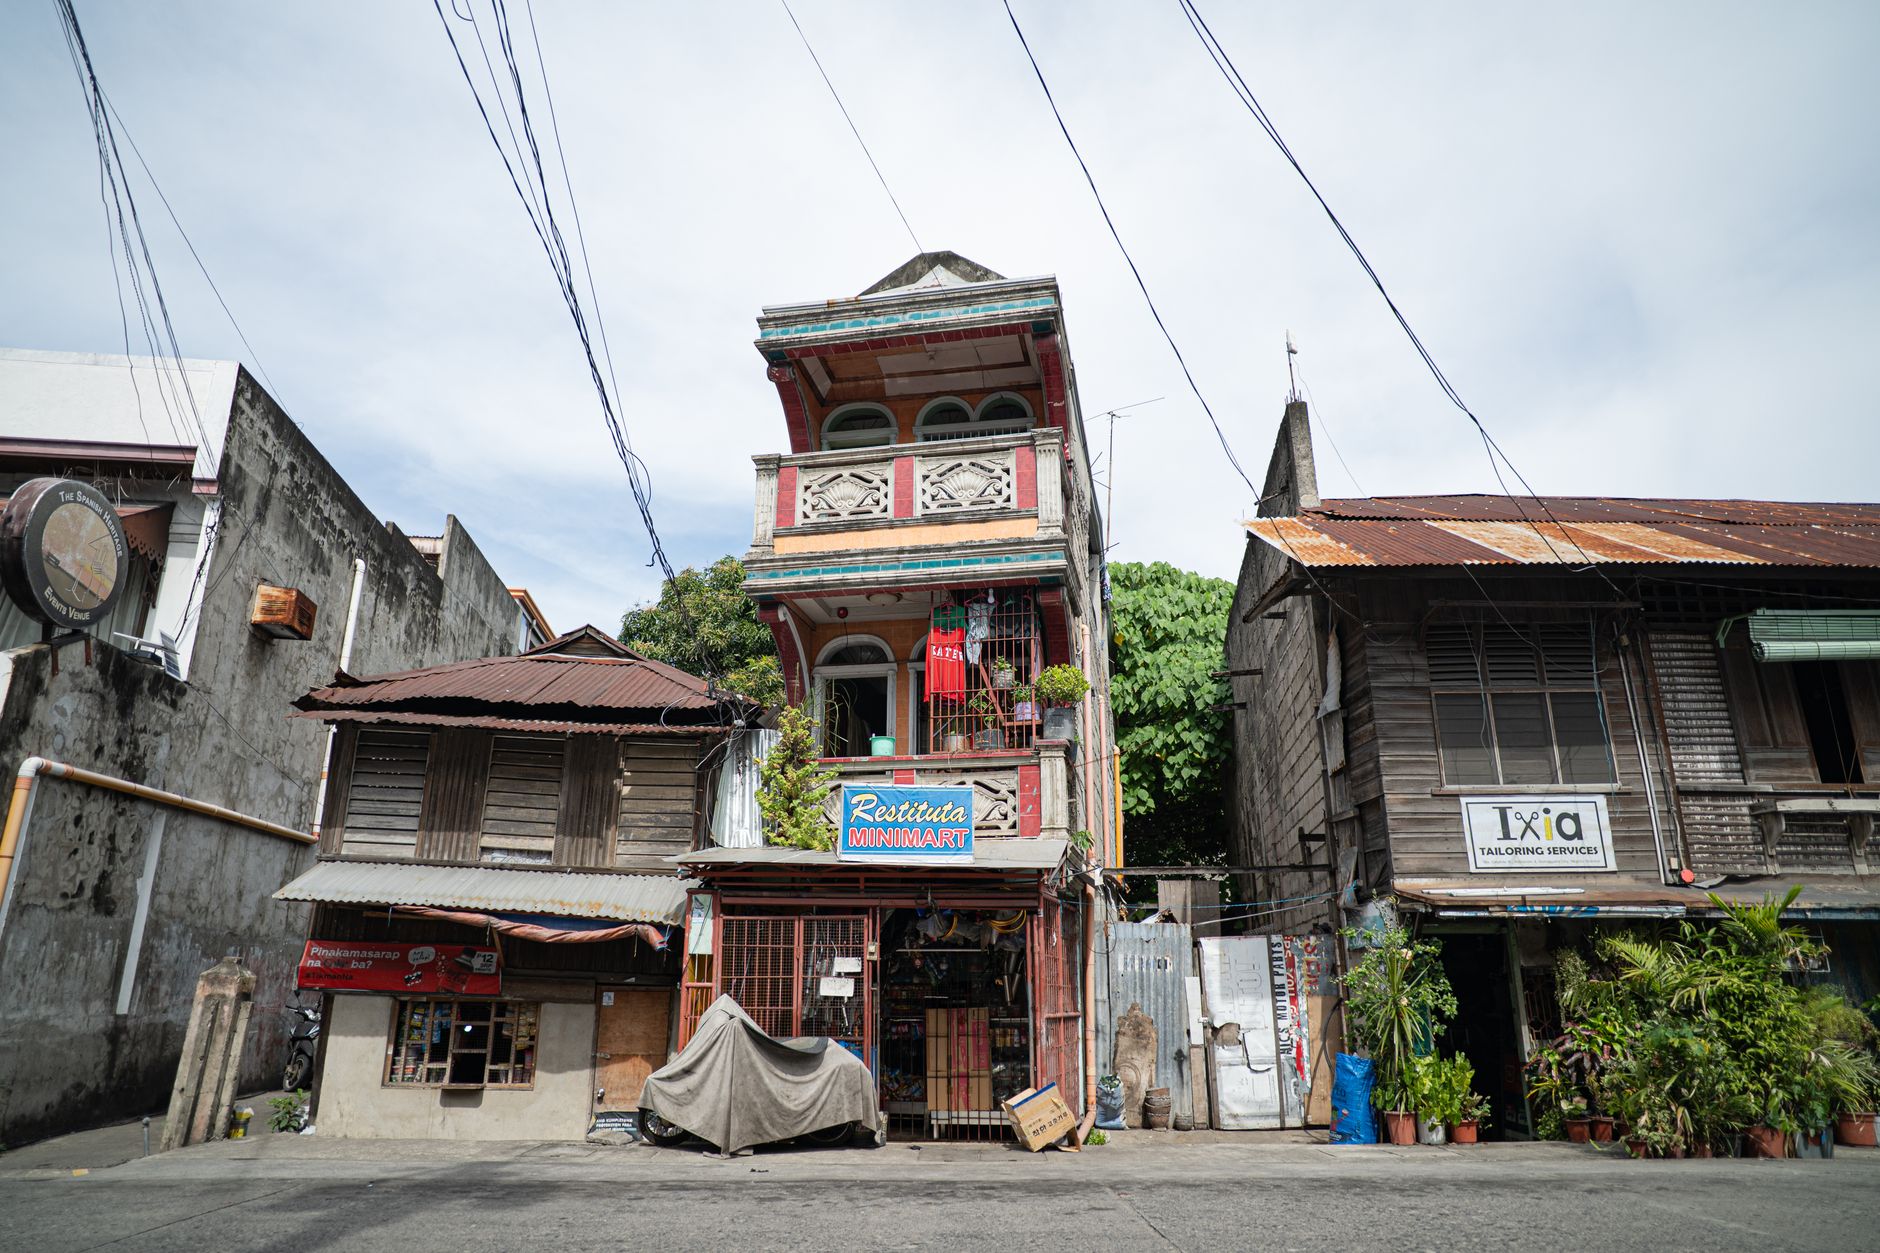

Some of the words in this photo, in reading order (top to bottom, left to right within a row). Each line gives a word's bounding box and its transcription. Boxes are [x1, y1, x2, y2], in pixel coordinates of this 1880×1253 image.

[850, 793, 968, 823] Restituta
[848, 827, 970, 848] MINIMART
[1479, 846, 1544, 856] TAILORING
[1547, 846, 1599, 855] SERVICES
[310, 946, 400, 960] Pinakamasarap
[306, 959, 321, 967] na
[351, 959, 372, 969] ba?
